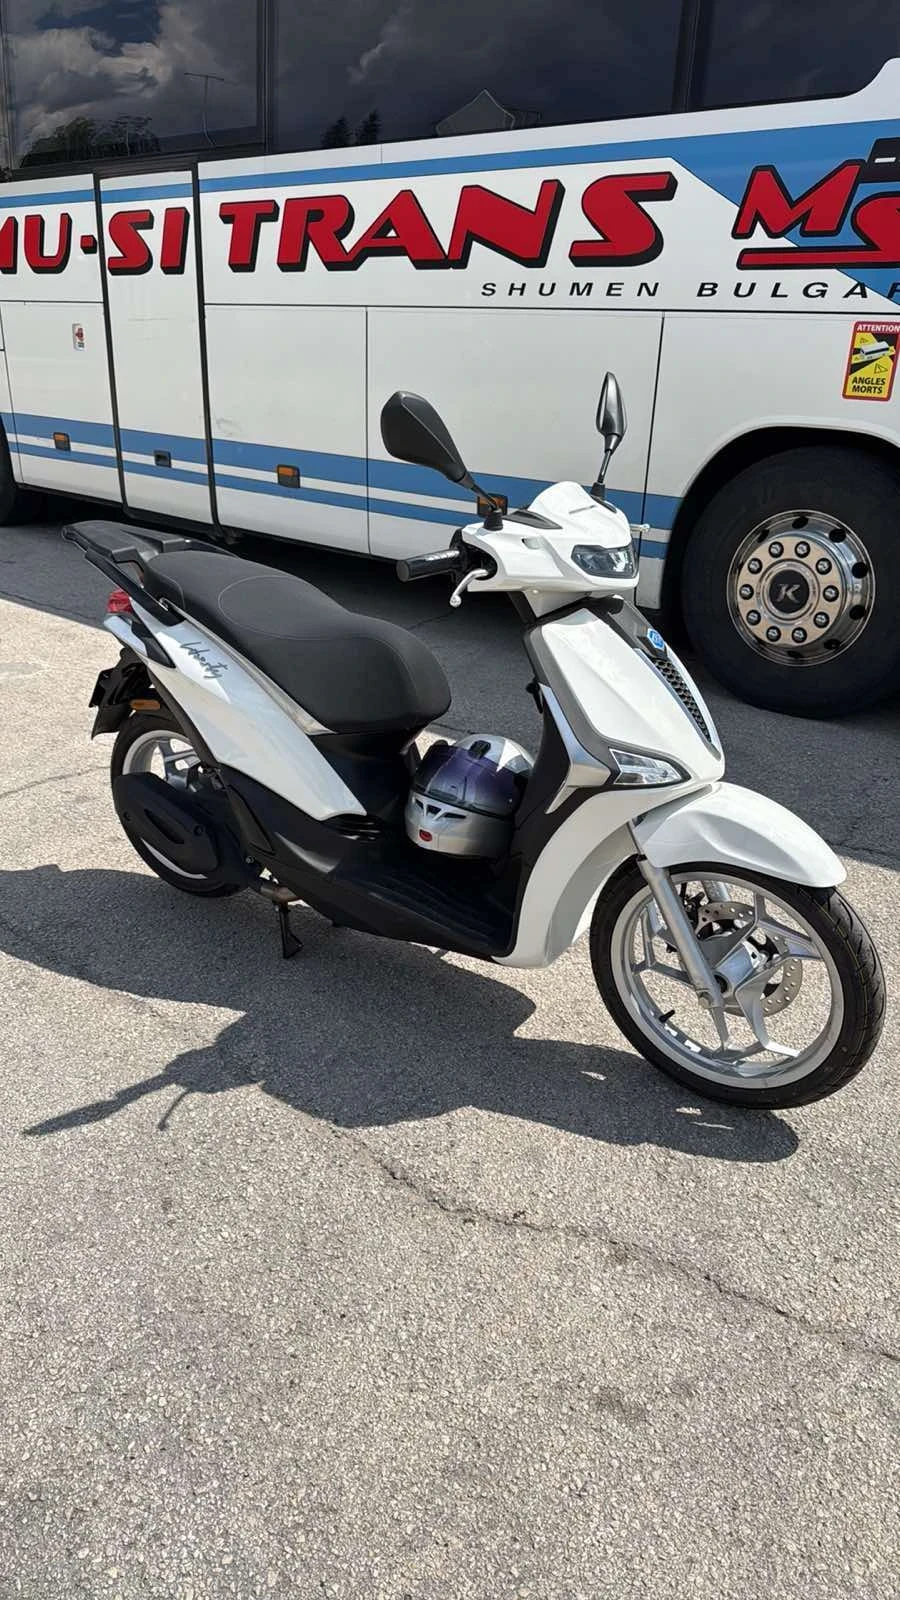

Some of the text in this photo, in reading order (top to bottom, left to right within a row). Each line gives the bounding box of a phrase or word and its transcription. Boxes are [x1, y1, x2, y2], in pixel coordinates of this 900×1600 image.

[219, 171, 678, 273] TRANS
[481, 282, 660, 297] SHUMEN
[857, 324, 900, 332] ATTENTION
[852, 377, 886, 385] ANGLES
[852, 385, 883, 394] MORTS
